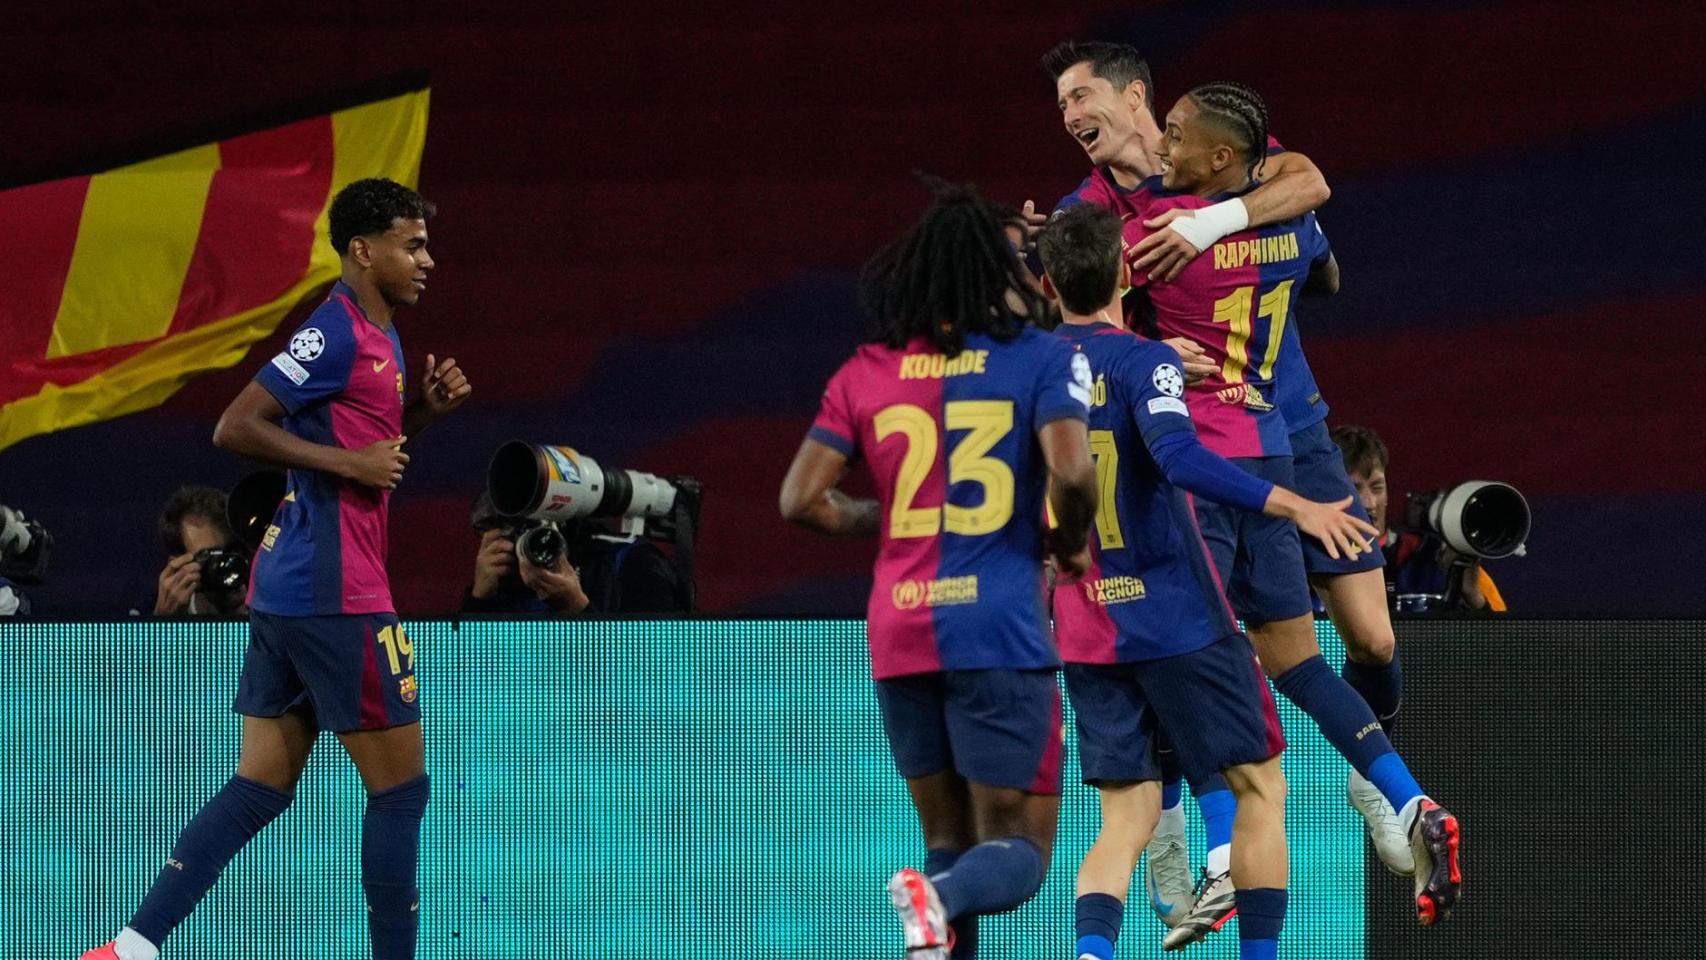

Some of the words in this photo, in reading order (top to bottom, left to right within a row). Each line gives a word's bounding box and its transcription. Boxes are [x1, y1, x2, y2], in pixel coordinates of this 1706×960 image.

[1214, 232, 1299, 270] RAPHINHA
[1213, 280, 1295, 383] 11
[873, 401, 1015, 539] 23
[1097, 585, 1146, 601] ACNUR
[377, 622, 414, 675] 19
